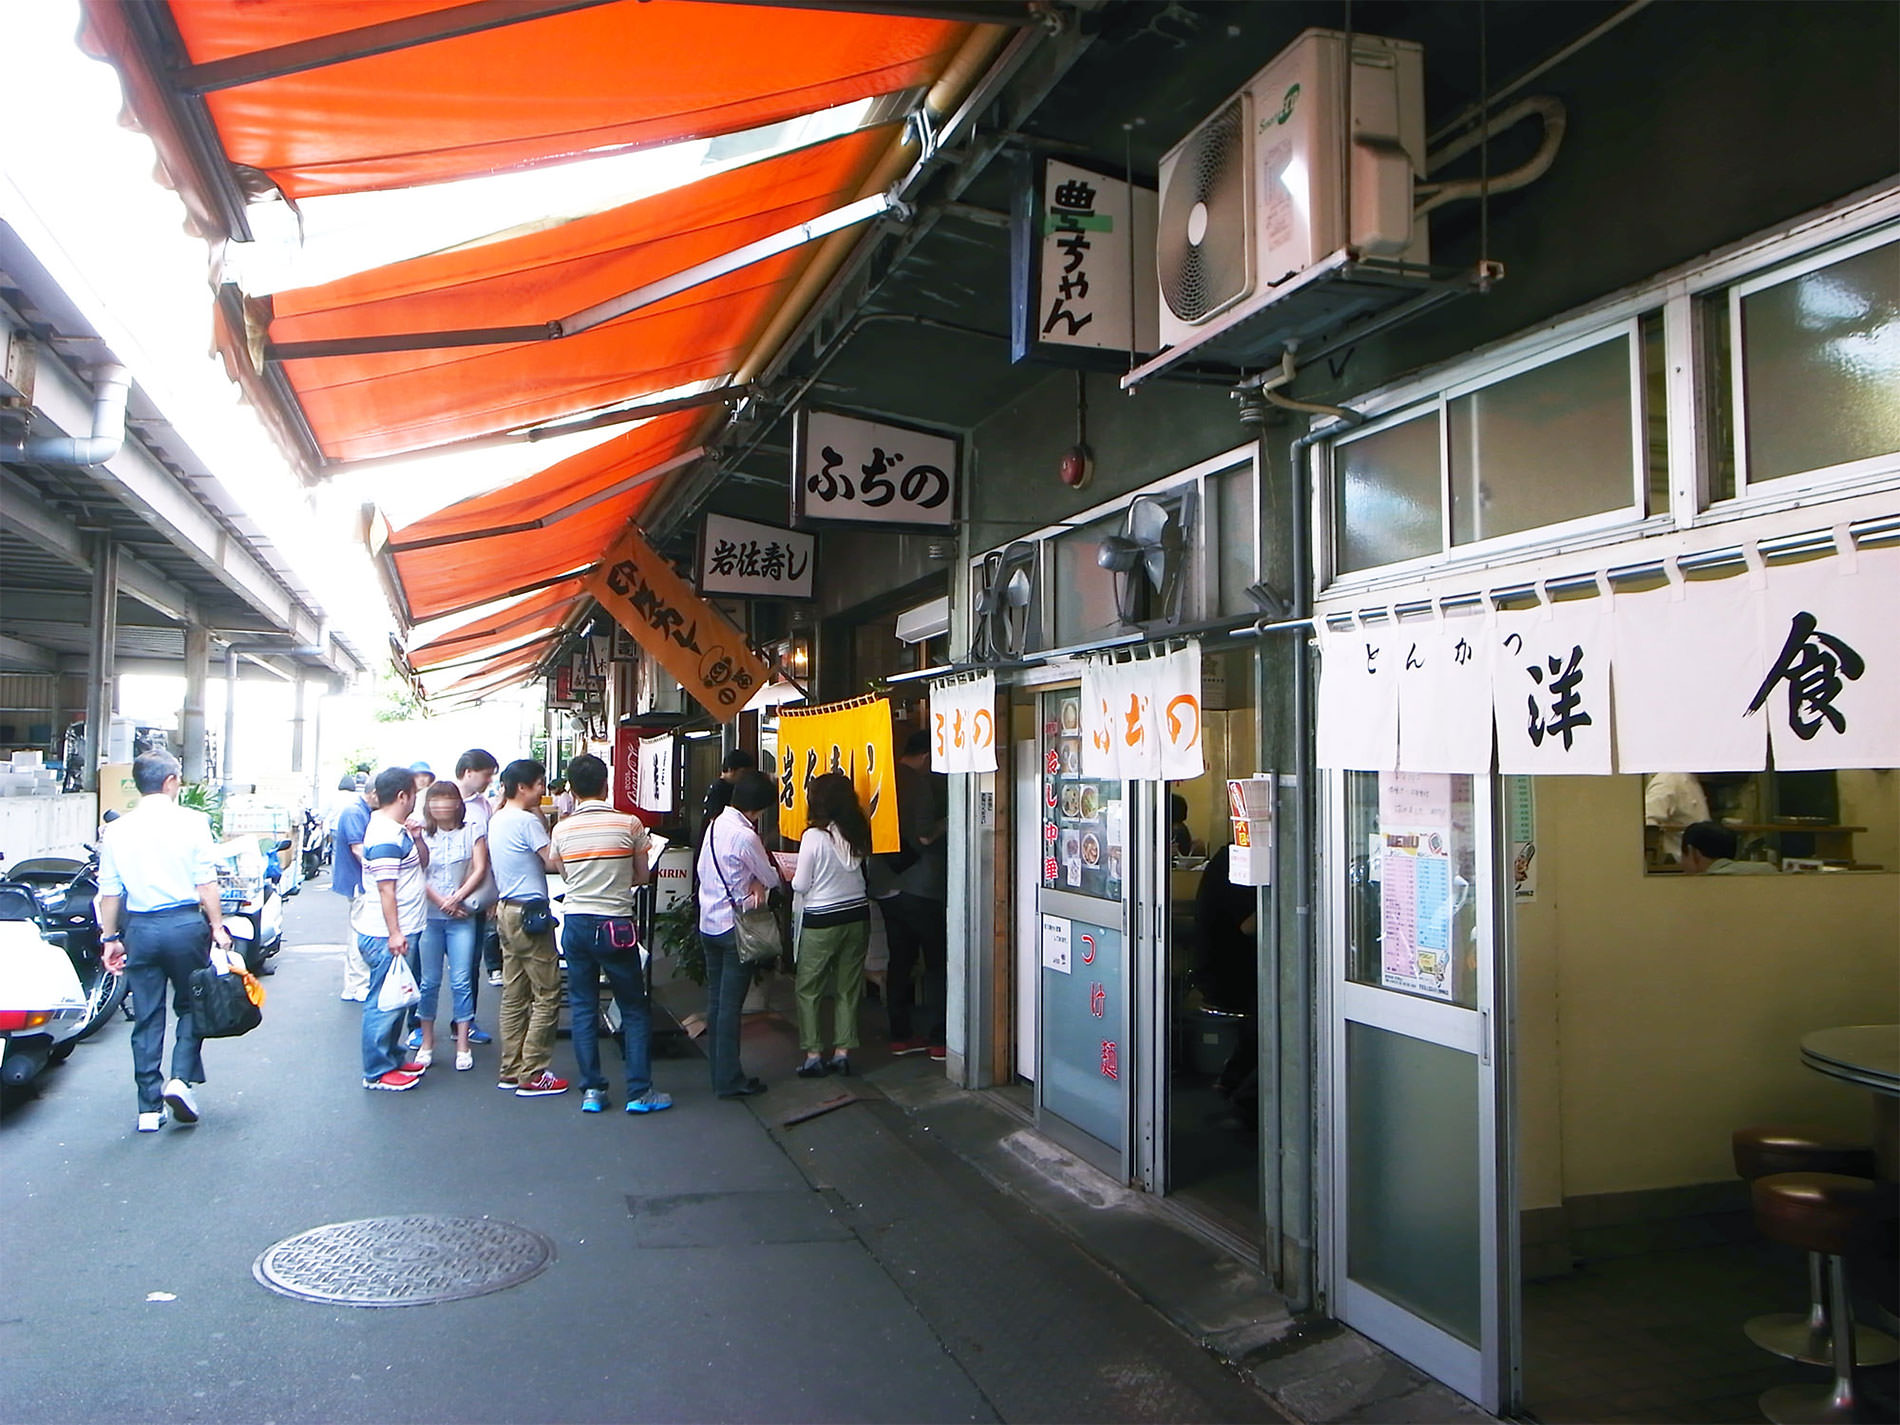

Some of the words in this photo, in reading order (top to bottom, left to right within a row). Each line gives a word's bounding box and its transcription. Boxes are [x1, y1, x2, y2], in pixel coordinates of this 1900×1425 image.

[1042, 179, 1096, 336] 豊ちゃん
[807, 446, 950, 509] ふぢの
[709, 538, 809, 581] 岩佐寿し
[1364, 632, 1523, 675] とんかつ
[1044, 748, 1060, 881] 冷し中華
[657, 868, 688, 880] KIRIN
[1080, 933, 1119, 1081] つけ麺
